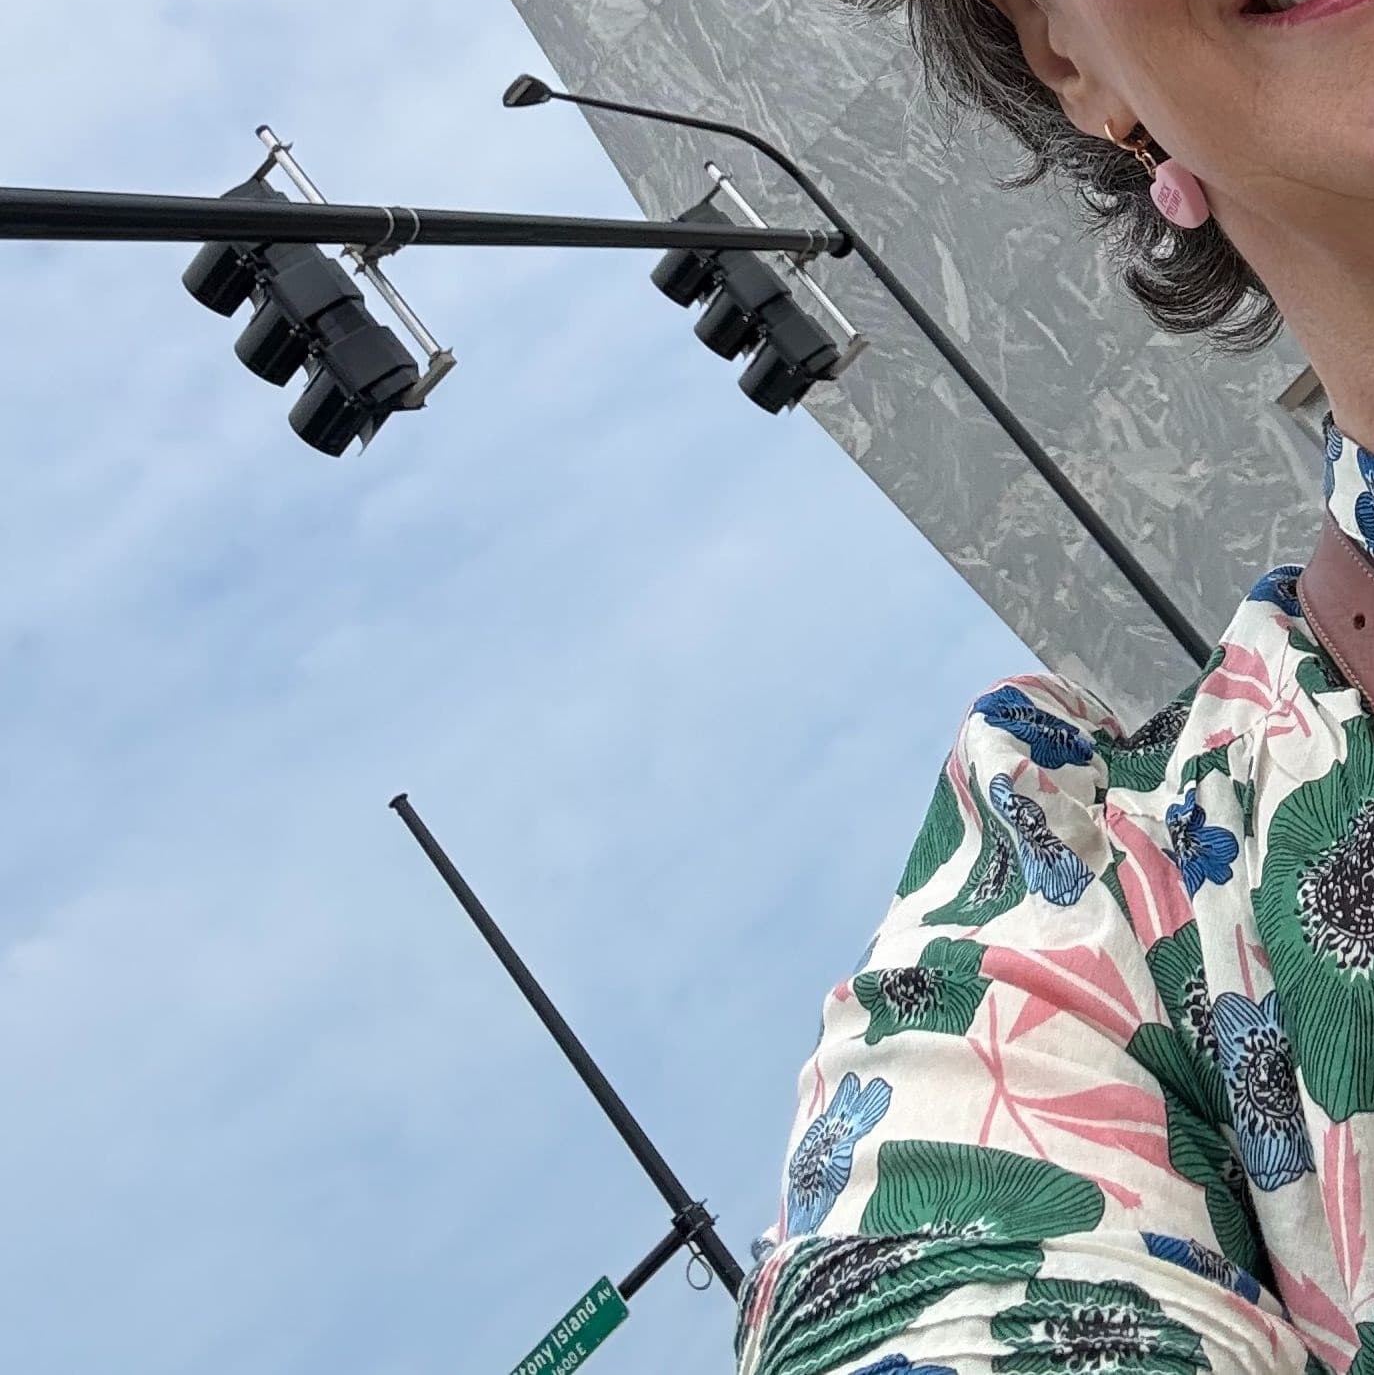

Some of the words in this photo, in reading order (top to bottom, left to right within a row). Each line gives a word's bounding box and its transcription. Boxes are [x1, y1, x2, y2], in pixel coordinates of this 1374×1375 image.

[512, 1342, 556, 1375] tony
[550, 1296, 598, 1350] Island
[597, 1286, 613, 1306] Av
[575, 1341, 588, 1356] E
